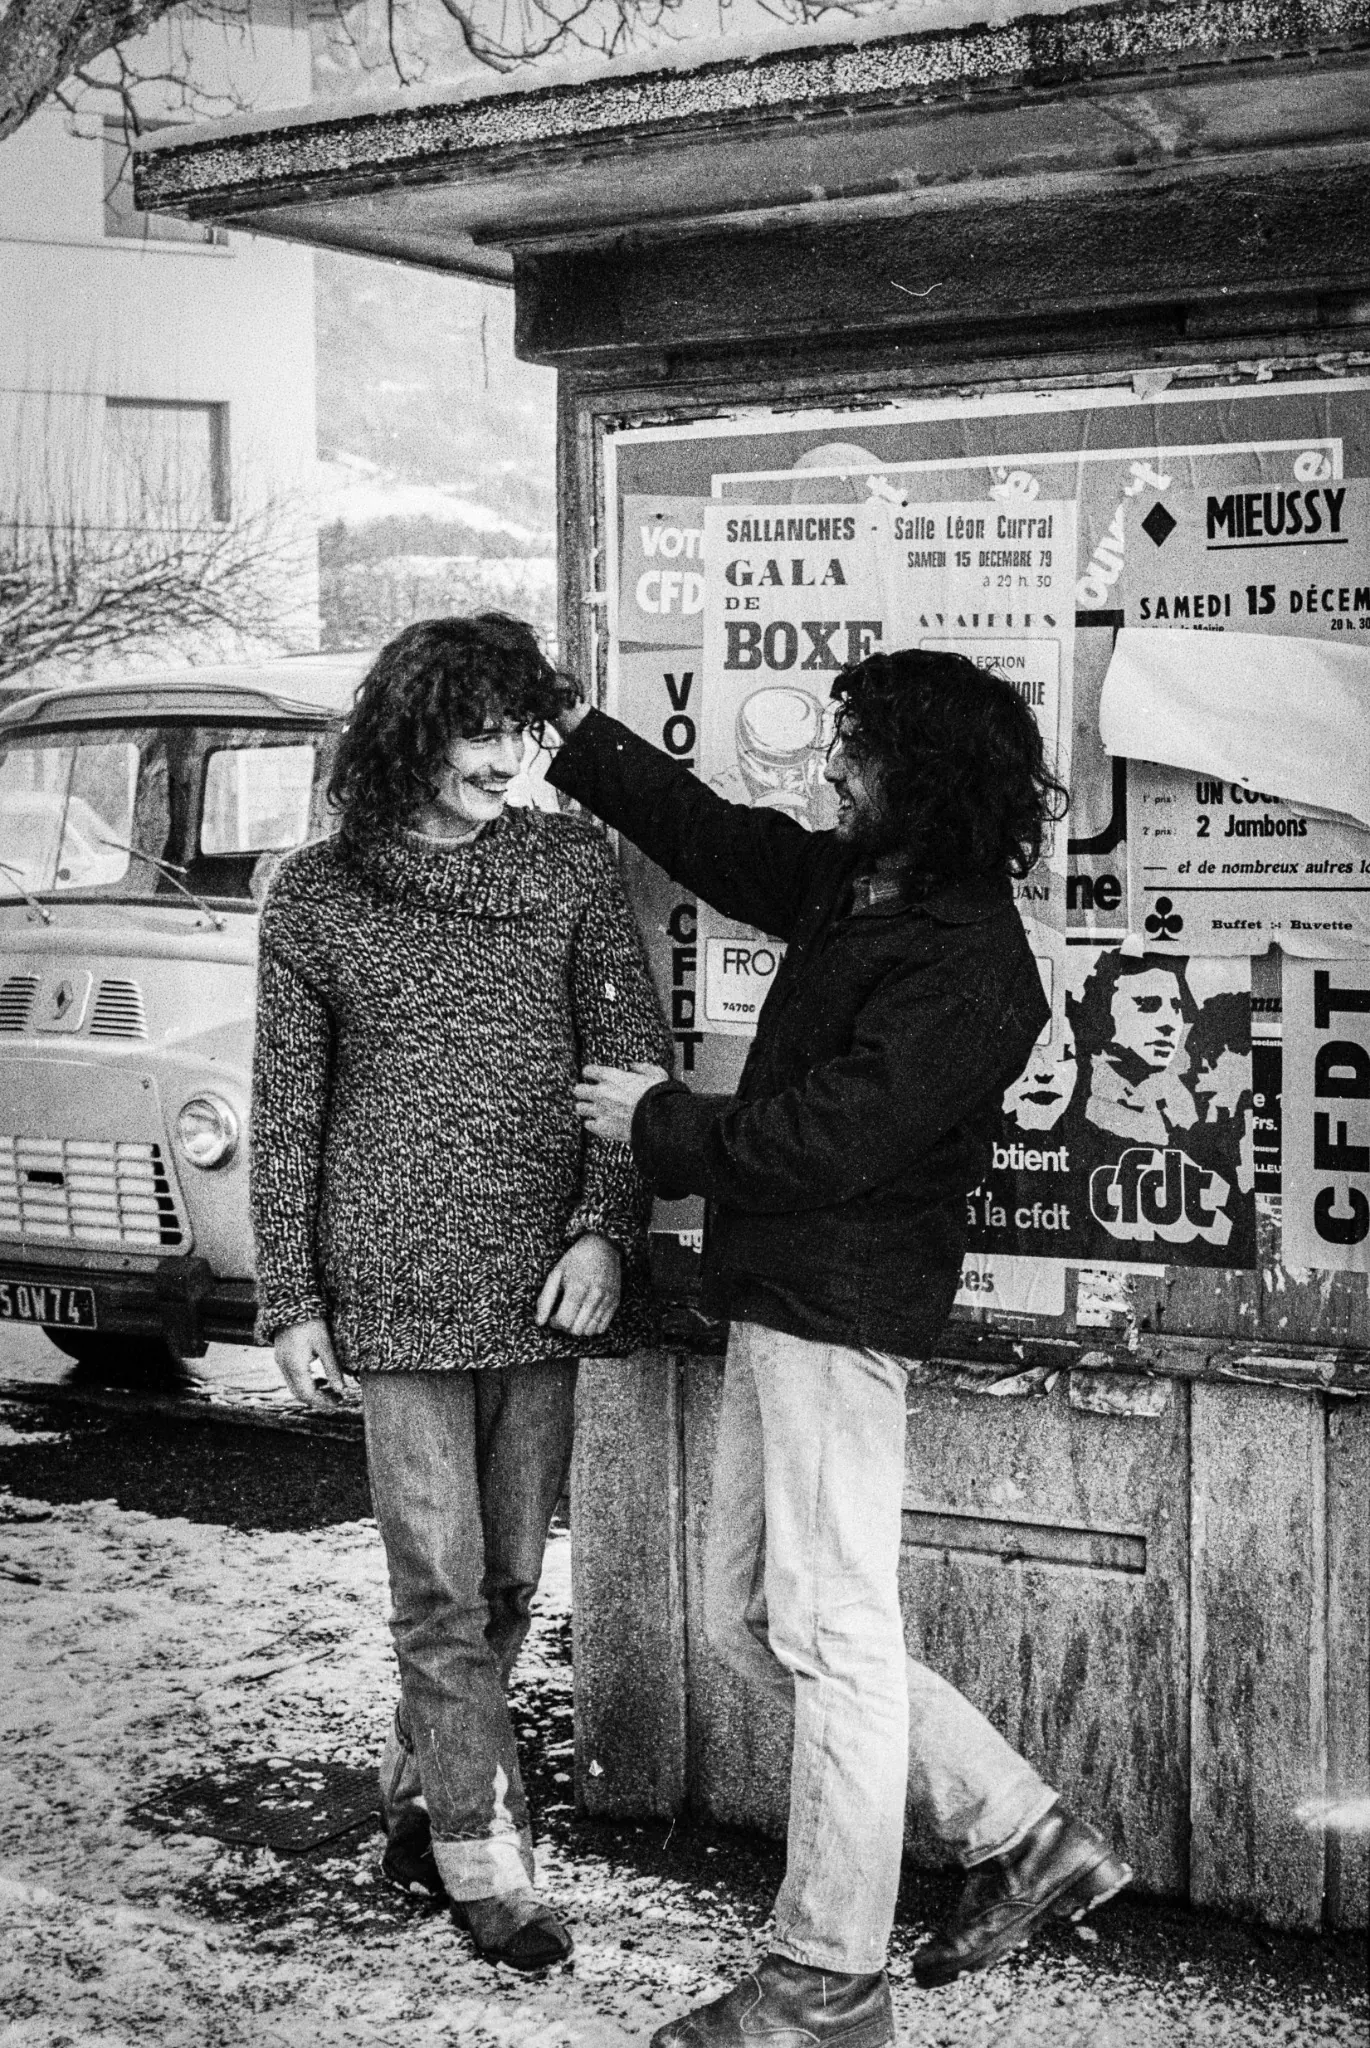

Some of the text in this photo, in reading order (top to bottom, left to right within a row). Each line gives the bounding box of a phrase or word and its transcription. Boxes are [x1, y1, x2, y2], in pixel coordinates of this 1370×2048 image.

[1206, 488, 1346, 539] MIEUSSY
[727, 517, 855, 542] SALLANCHES
[895, 516, 935, 540] Salle
[947, 515, 985, 539] Léon
[997, 514, 1053, 540] Curral
[907, 551, 947, 568] SAMEDI
[955, 551, 971, 567] 15
[1040, 550, 1053, 567] 79
[725, 558, 848, 587] GALA
[997, 574, 1011, 588] 20
[1036, 574, 1052, 587] 30
[726, 597, 760, 610] DE
[1140, 583, 1370, 620] SAMEDI 15 DÉCEM
[1331, 618, 1344, 631] 20
[1346, 618, 1357, 631] h.
[970, 656, 1025, 669] ECTION
[663, 672, 696, 769] VO
[1196, 782, 1223, 805] UN
[1196, 814, 1308, 837] 2 Jambons
[1178, 860, 1191, 874] et
[1197, 860, 1216, 874] de
[1222, 860, 1298, 874] nombreux
[1305, 860, 1353, 874] autres
[1211, 919, 1262, 930] Buffet
[1290, 920, 1353, 931] Buvette
[1314, 970, 1370, 1245] CFDT
[1089, 1147, 1232, 1246] cfdt
[985, 1200, 1007, 1227] la
[1014, 1202, 1071, 1230] cfdt
